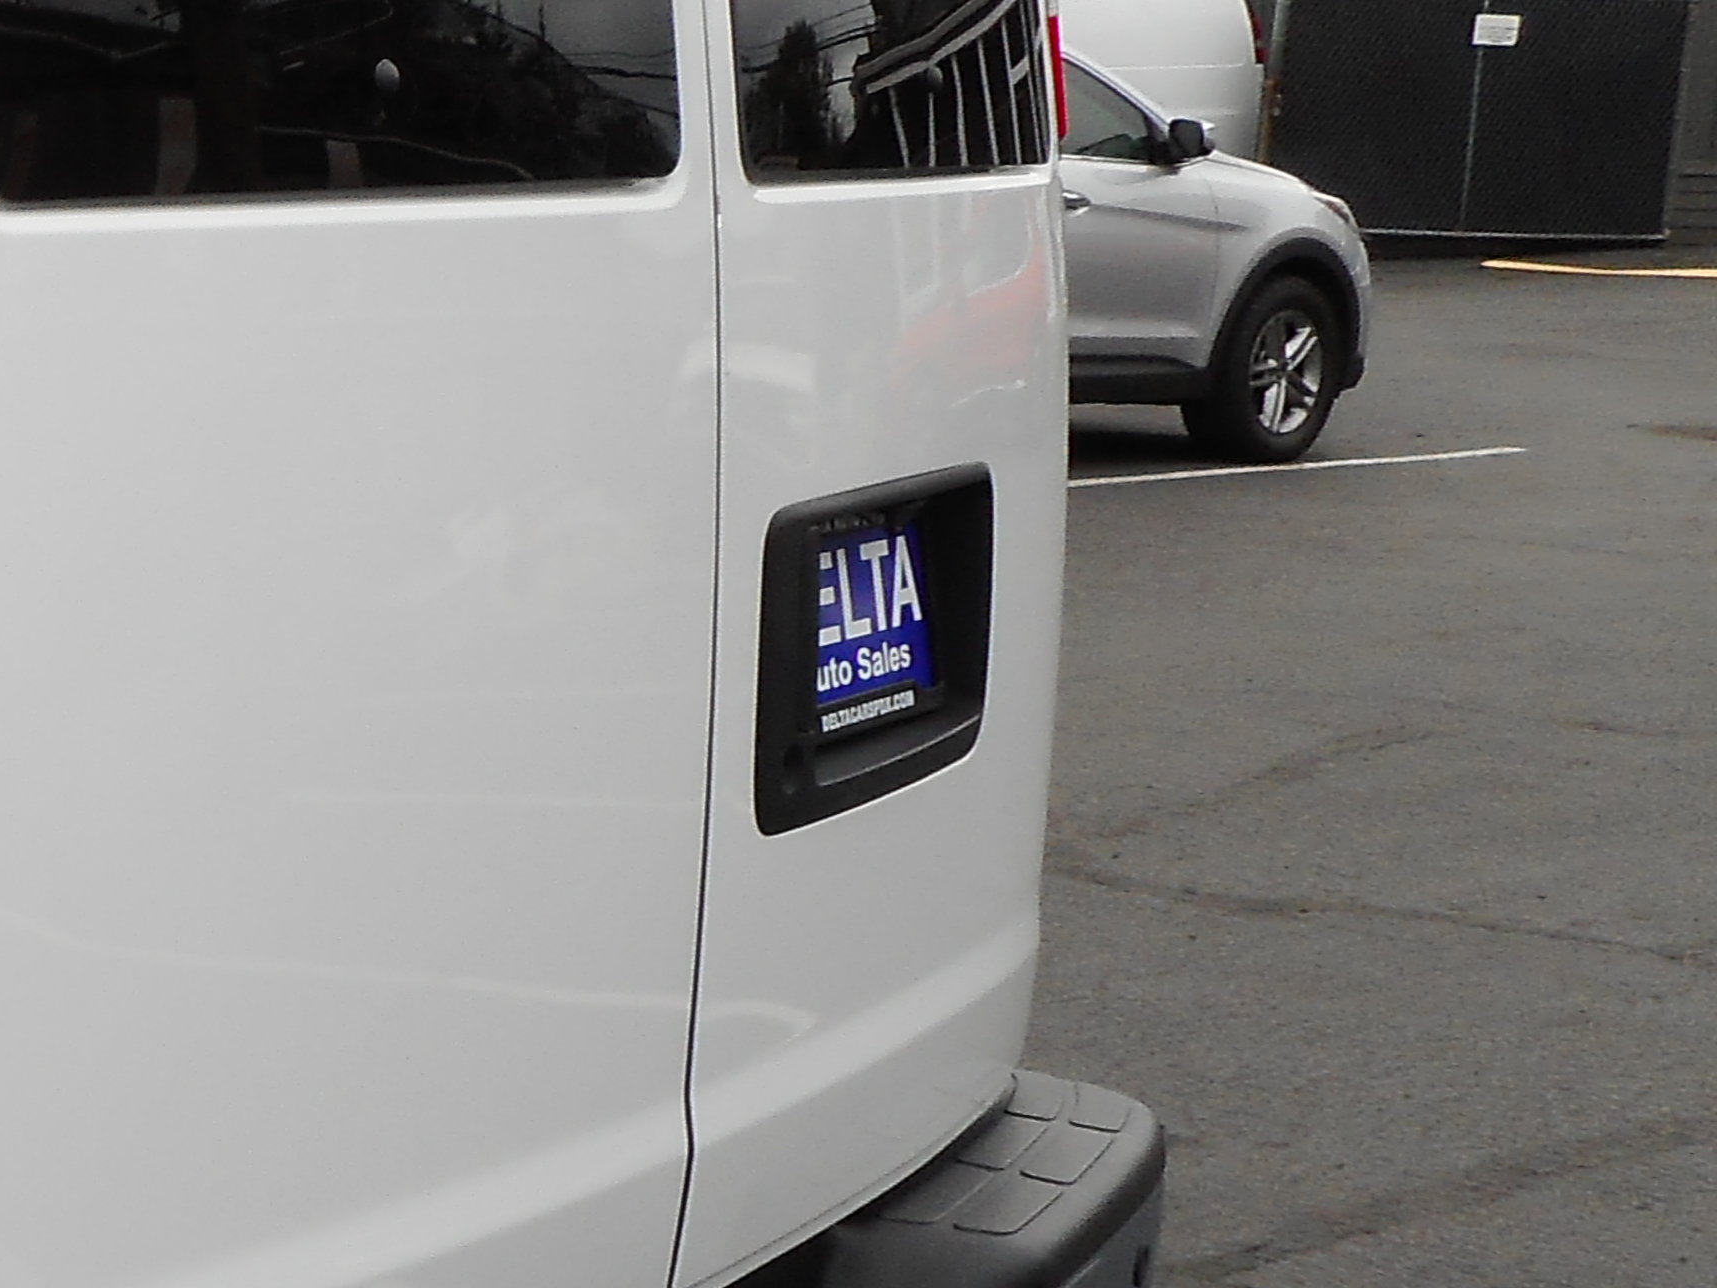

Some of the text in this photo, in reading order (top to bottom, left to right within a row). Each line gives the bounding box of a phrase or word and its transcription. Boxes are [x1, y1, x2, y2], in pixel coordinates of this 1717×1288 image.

[818, 534, 923, 647] ELTA
[816, 643, 911, 692] uto Sales
